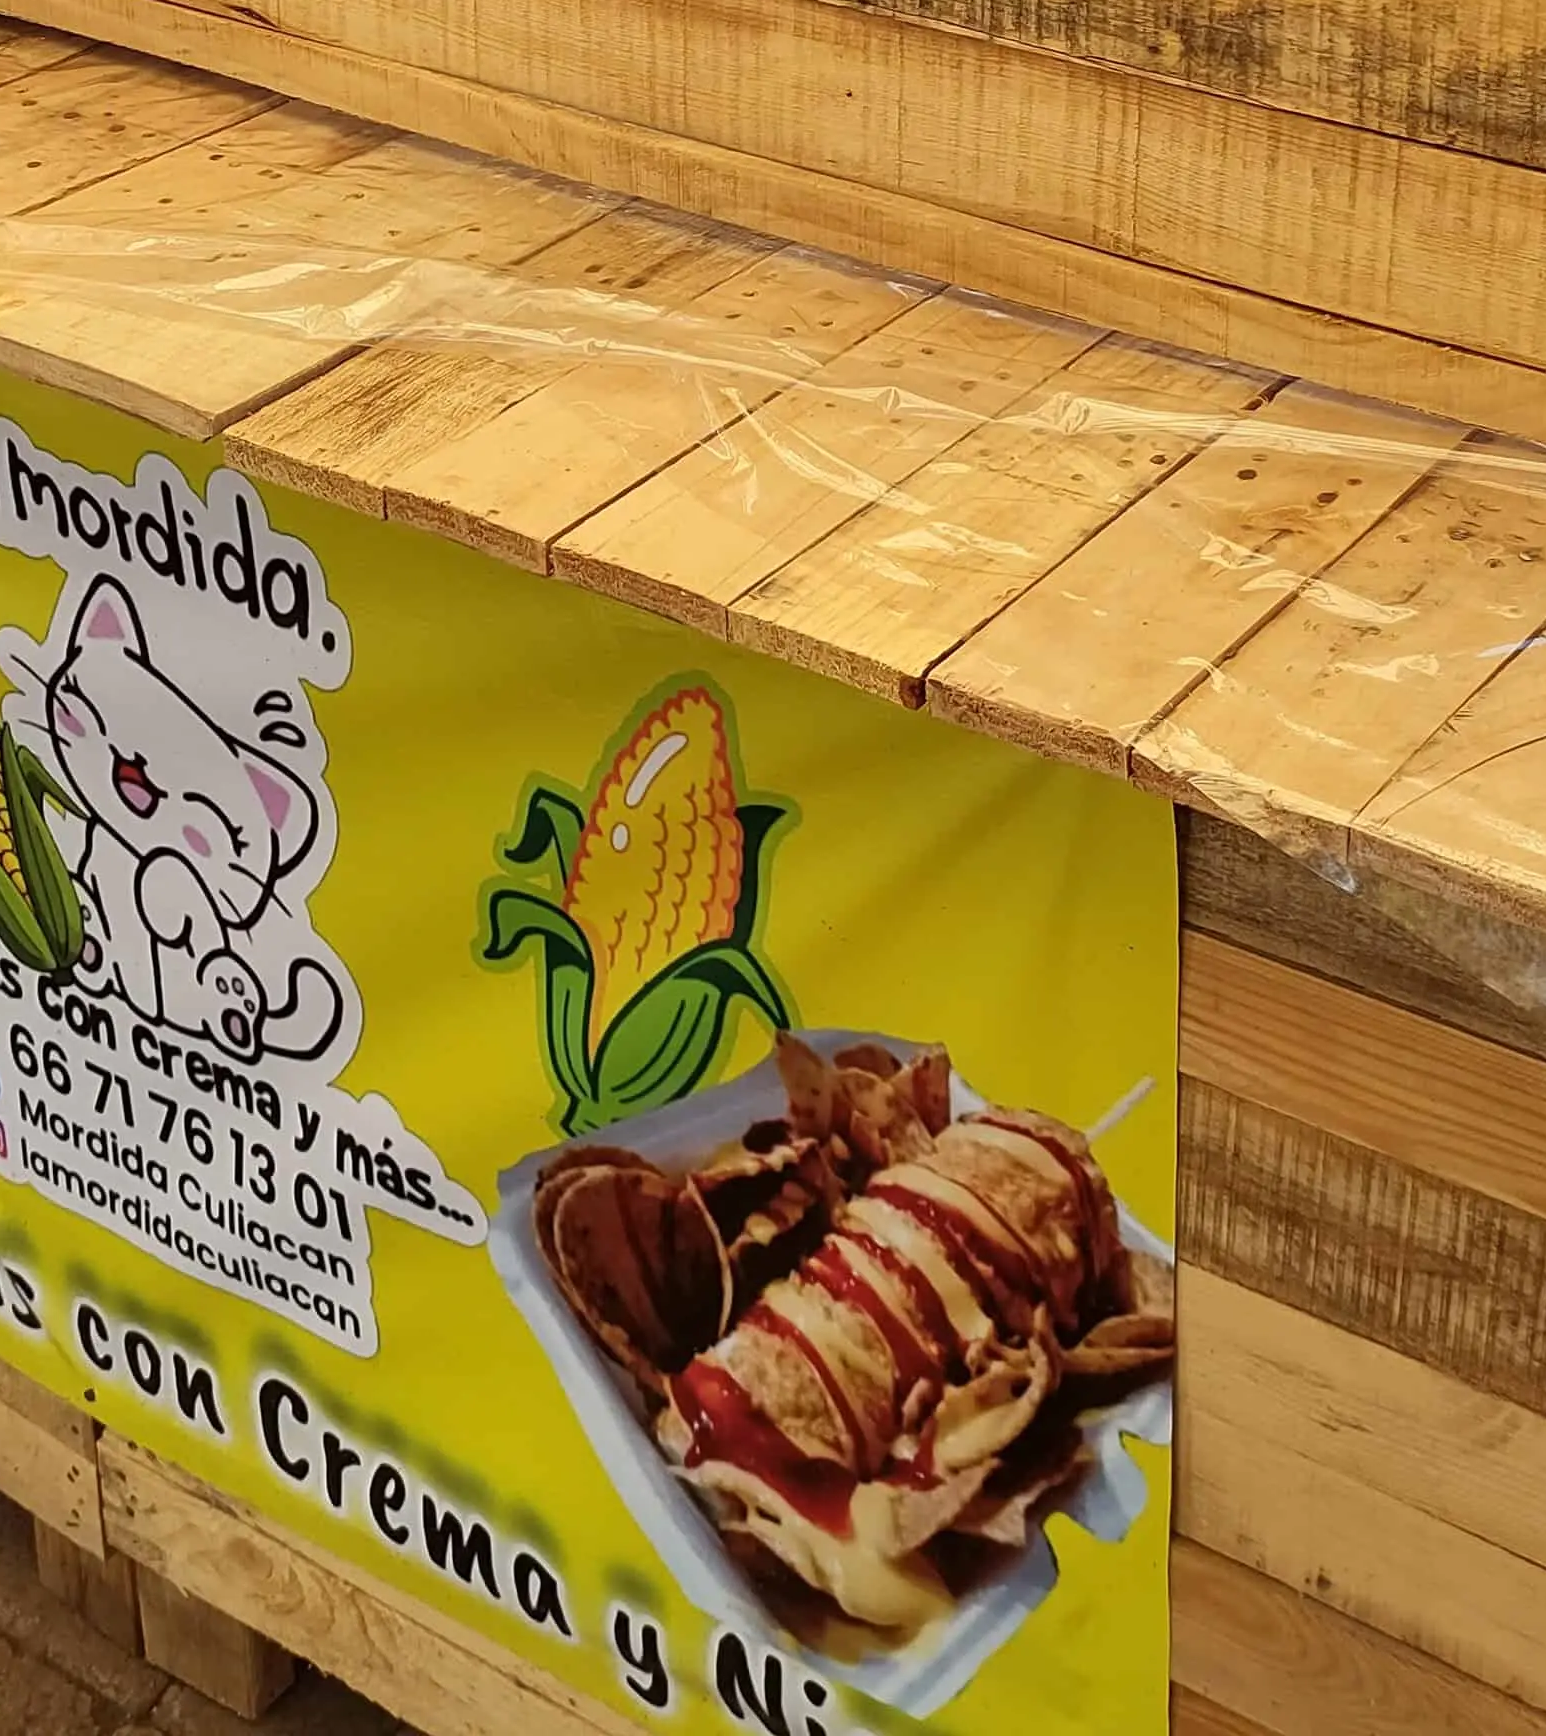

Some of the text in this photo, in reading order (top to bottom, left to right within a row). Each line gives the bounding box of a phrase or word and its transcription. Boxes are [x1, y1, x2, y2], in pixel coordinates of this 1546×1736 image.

[9, 1023, 354, 1242] 66 71 76 13 01
[37, 975, 117, 1051] con
[134, 1021, 282, 1130] crema
[294, 1102, 321, 1154] y
[18, 1089, 356, 1286] Mordida Culiacan
[77, 1304, 225, 1434] con
[258, 1378, 573, 1637] Crema
[614, 1609, 669, 1708] y
